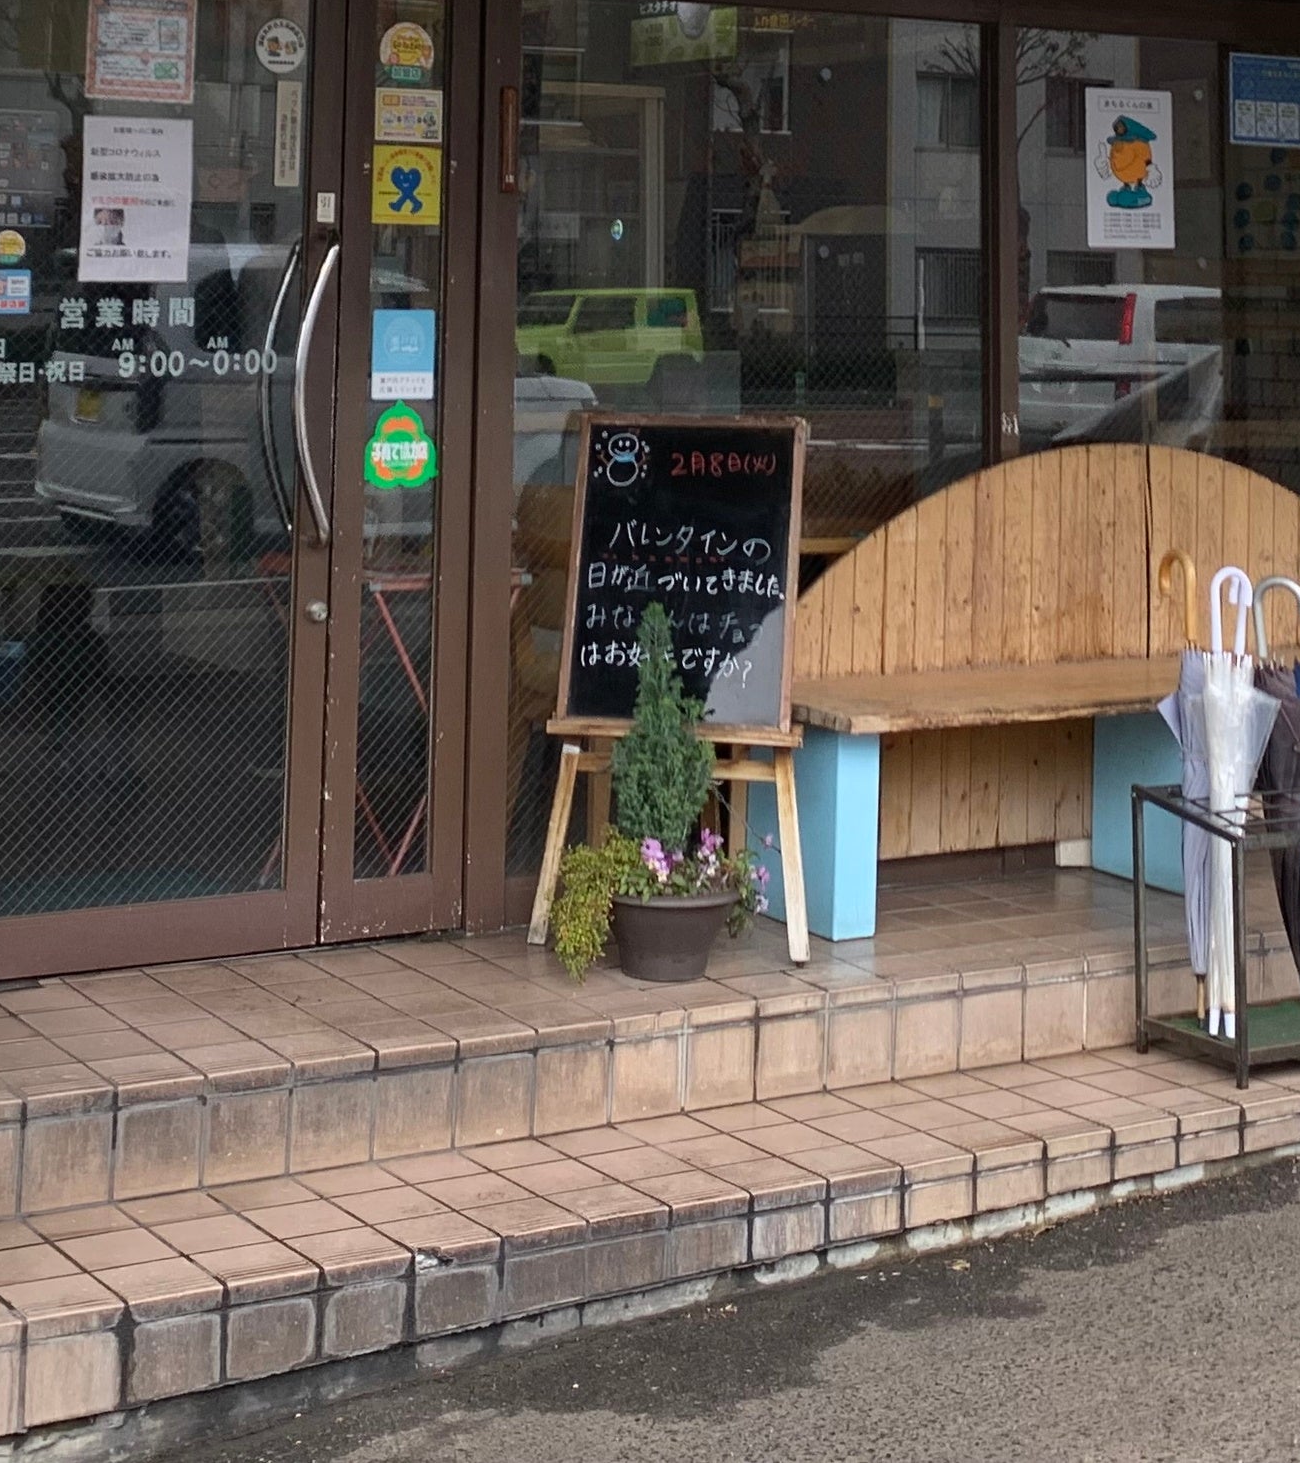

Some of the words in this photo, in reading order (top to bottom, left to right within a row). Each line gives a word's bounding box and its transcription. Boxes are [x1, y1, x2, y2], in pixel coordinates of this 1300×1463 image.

[59, 297, 195, 330] 営業時間
[112, 339, 134, 351] AM
[207, 336, 229, 349] AM
[671, 451, 778, 477] 2月8日(火)
[608, 518, 772, 566] バレンタインの
